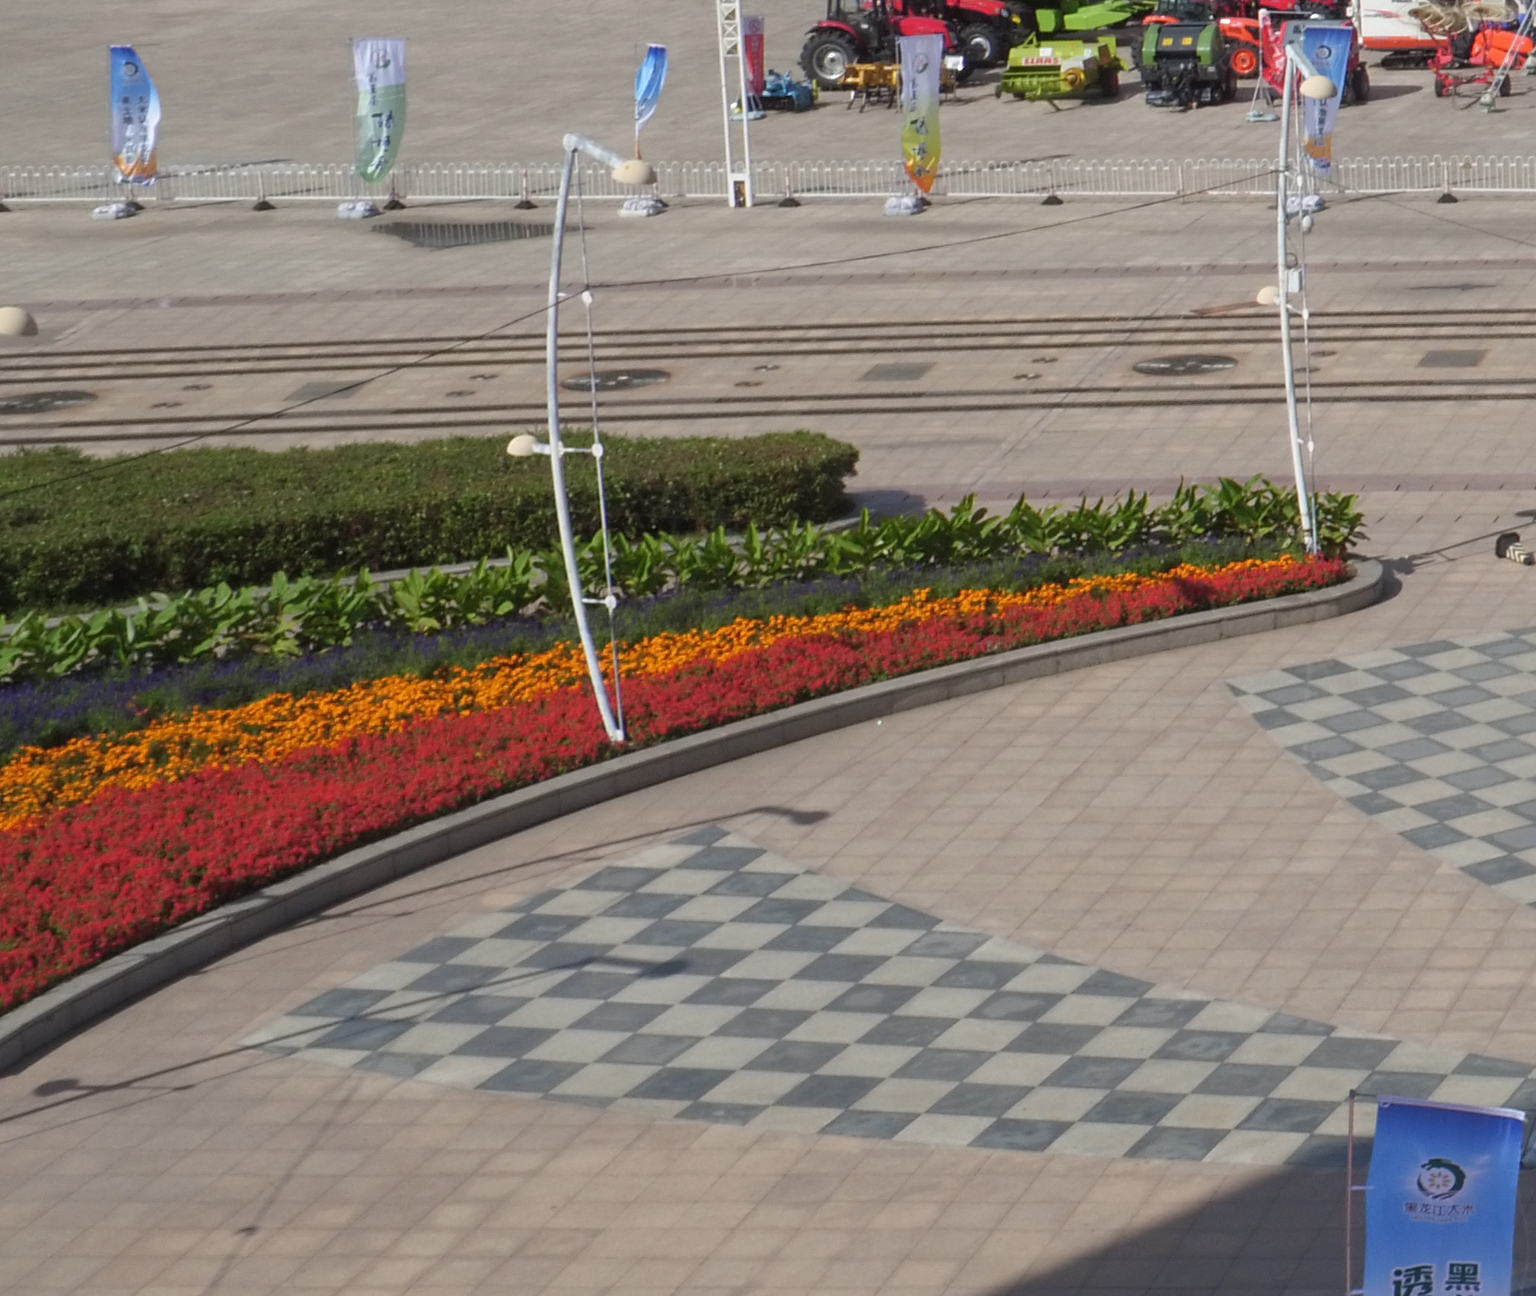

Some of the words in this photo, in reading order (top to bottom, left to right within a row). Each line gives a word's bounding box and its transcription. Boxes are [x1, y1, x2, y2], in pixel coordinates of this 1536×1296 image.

[1404, 1202, 1475, 1215] 黑龙江大米
